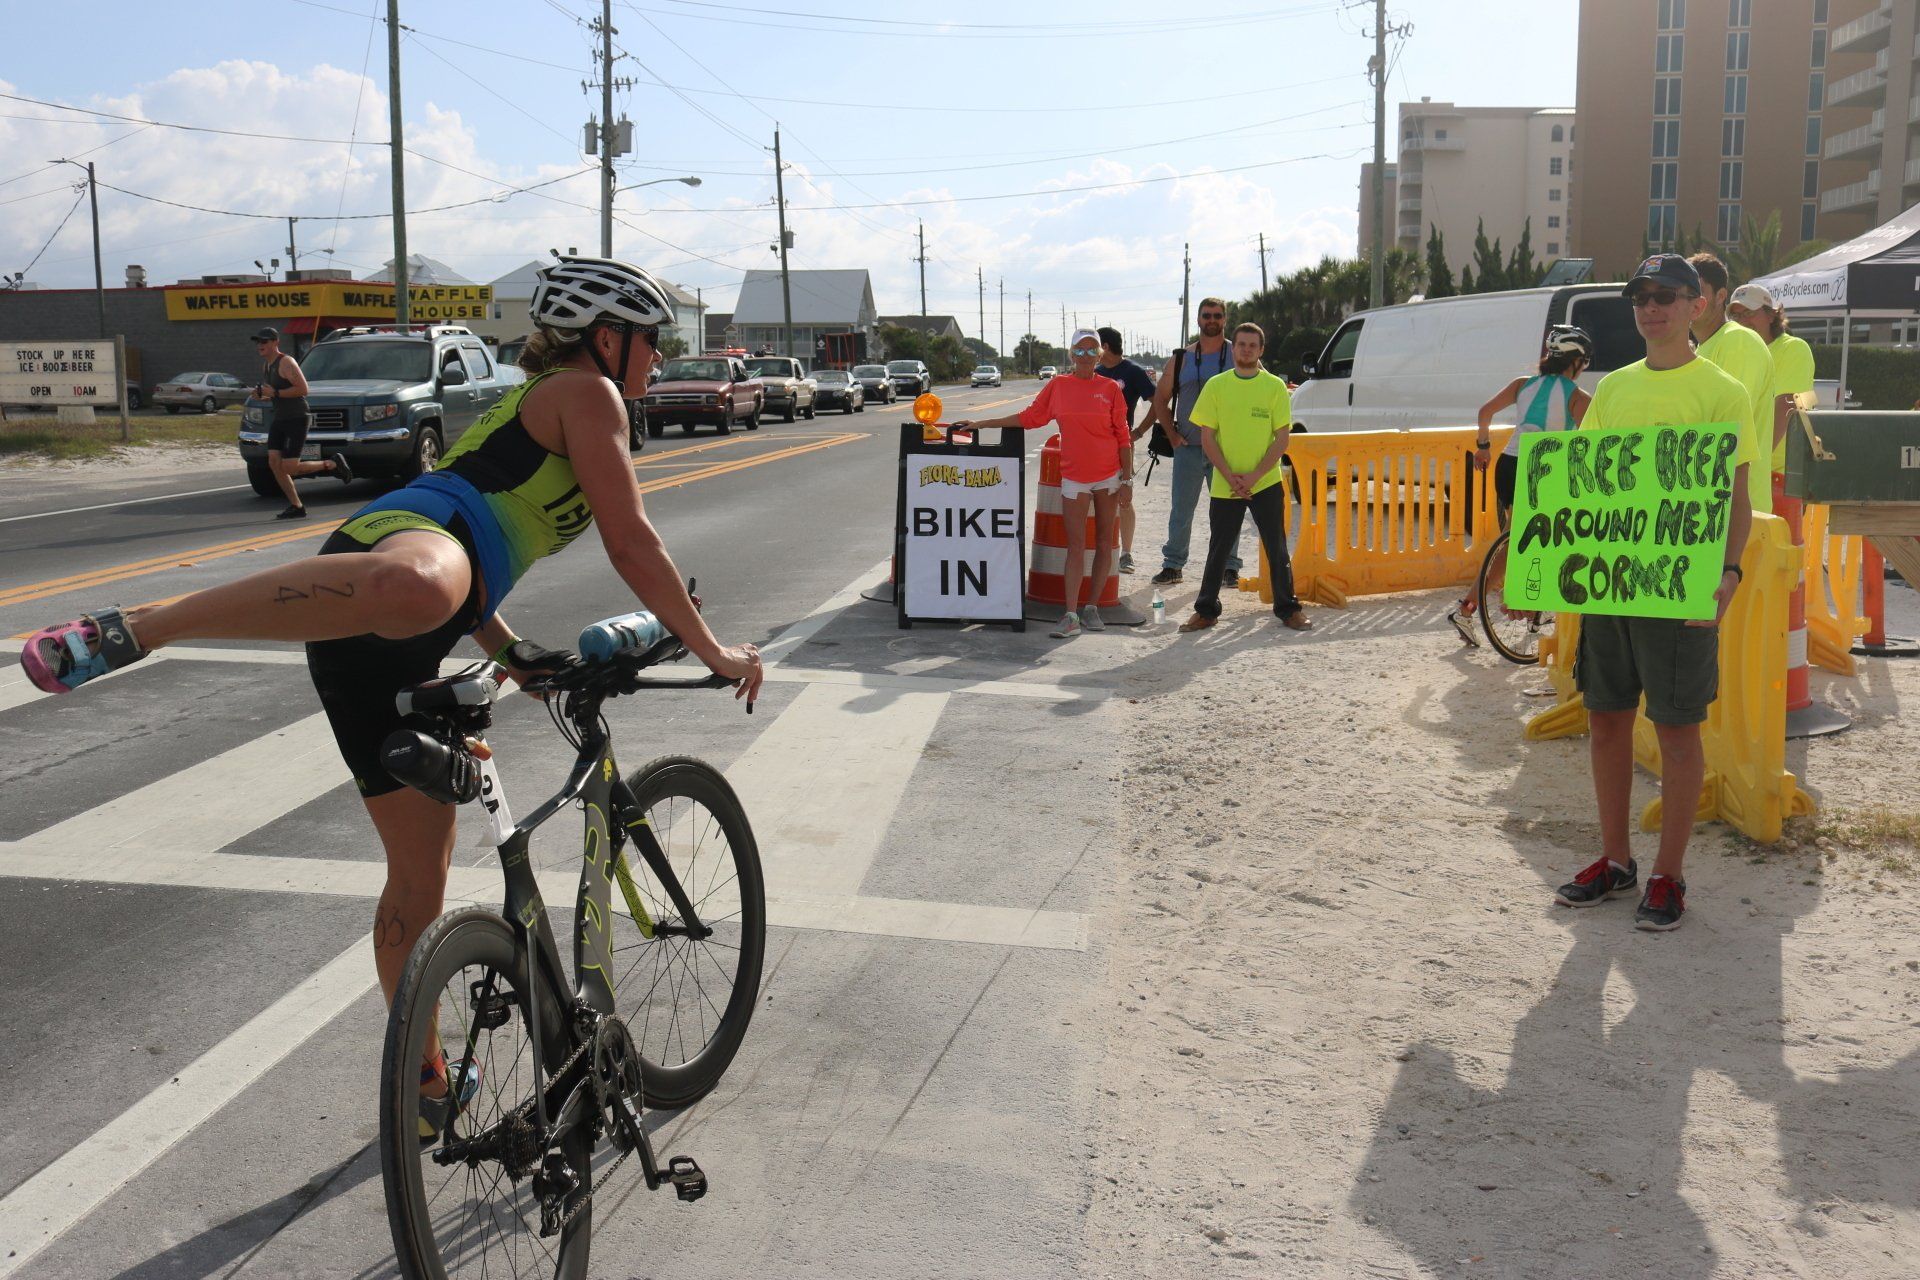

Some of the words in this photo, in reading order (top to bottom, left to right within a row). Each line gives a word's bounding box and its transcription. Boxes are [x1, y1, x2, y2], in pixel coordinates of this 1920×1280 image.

[185, 294, 249, 310] WAFFLE
[256, 292, 311, 308] HOUSE
[344, 292, 397, 308] WAFFLE
[413, 306, 482, 318] HOUSE
[17, 350, 43, 360] STOCK
[54, 350, 64, 360] UP
[73, 350, 95, 360] HERE
[20, 363, 34, 372] ICE
[31, 386, 51, 396] OPEN
[74, 386, 96, 396] 10AM
[919, 464, 1002, 488] FLORA-BAMA
[1527, 433, 1644, 510] FREE
[1655, 429, 1738, 492] BEER
[913, 507, 1015, 539] BIKE
[1517, 507, 1648, 554] AROUND
[1654, 489, 1731, 546] NEXT
[940, 559, 988, 597] IN
[1558, 552, 1690, 605] CORNER
